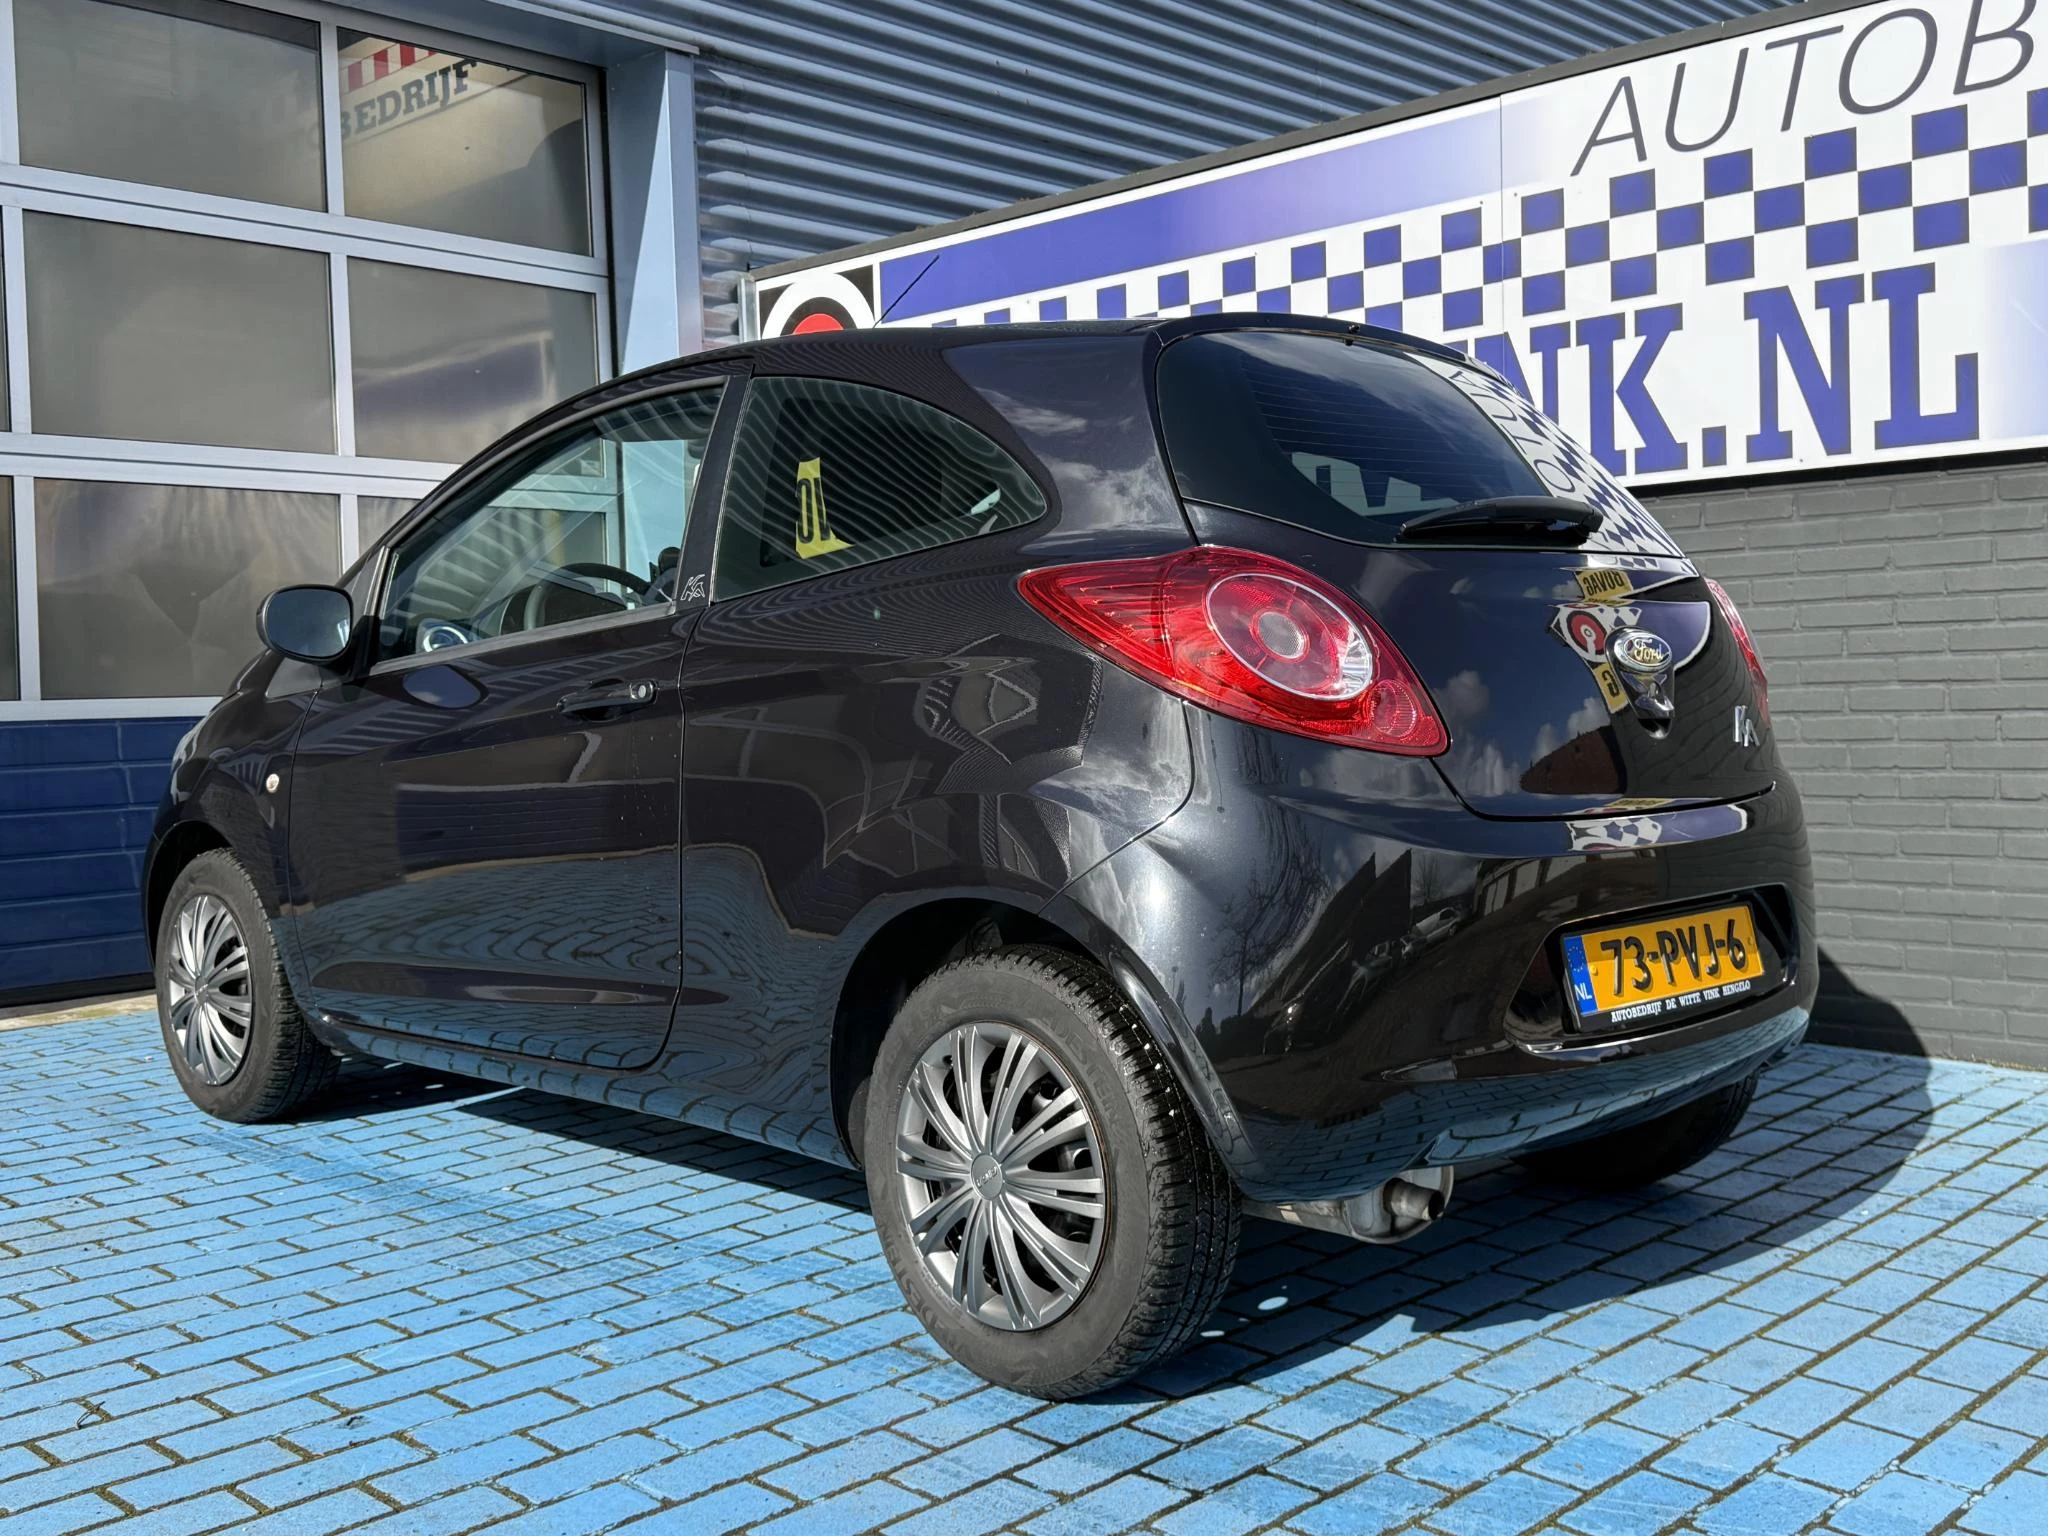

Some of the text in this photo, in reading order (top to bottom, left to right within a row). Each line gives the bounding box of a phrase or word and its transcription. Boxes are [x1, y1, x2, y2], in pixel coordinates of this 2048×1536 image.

[1634, 638, 1665, 661] Ford
[1600, 919, 1748, 996] 73-PVJ-6
[1574, 983, 1593, 1001] NL
[1665, 998, 1678, 1010] DE
[1702, 987, 1721, 1001] VINK
[1722, 980, 1751, 996] HENGELO
